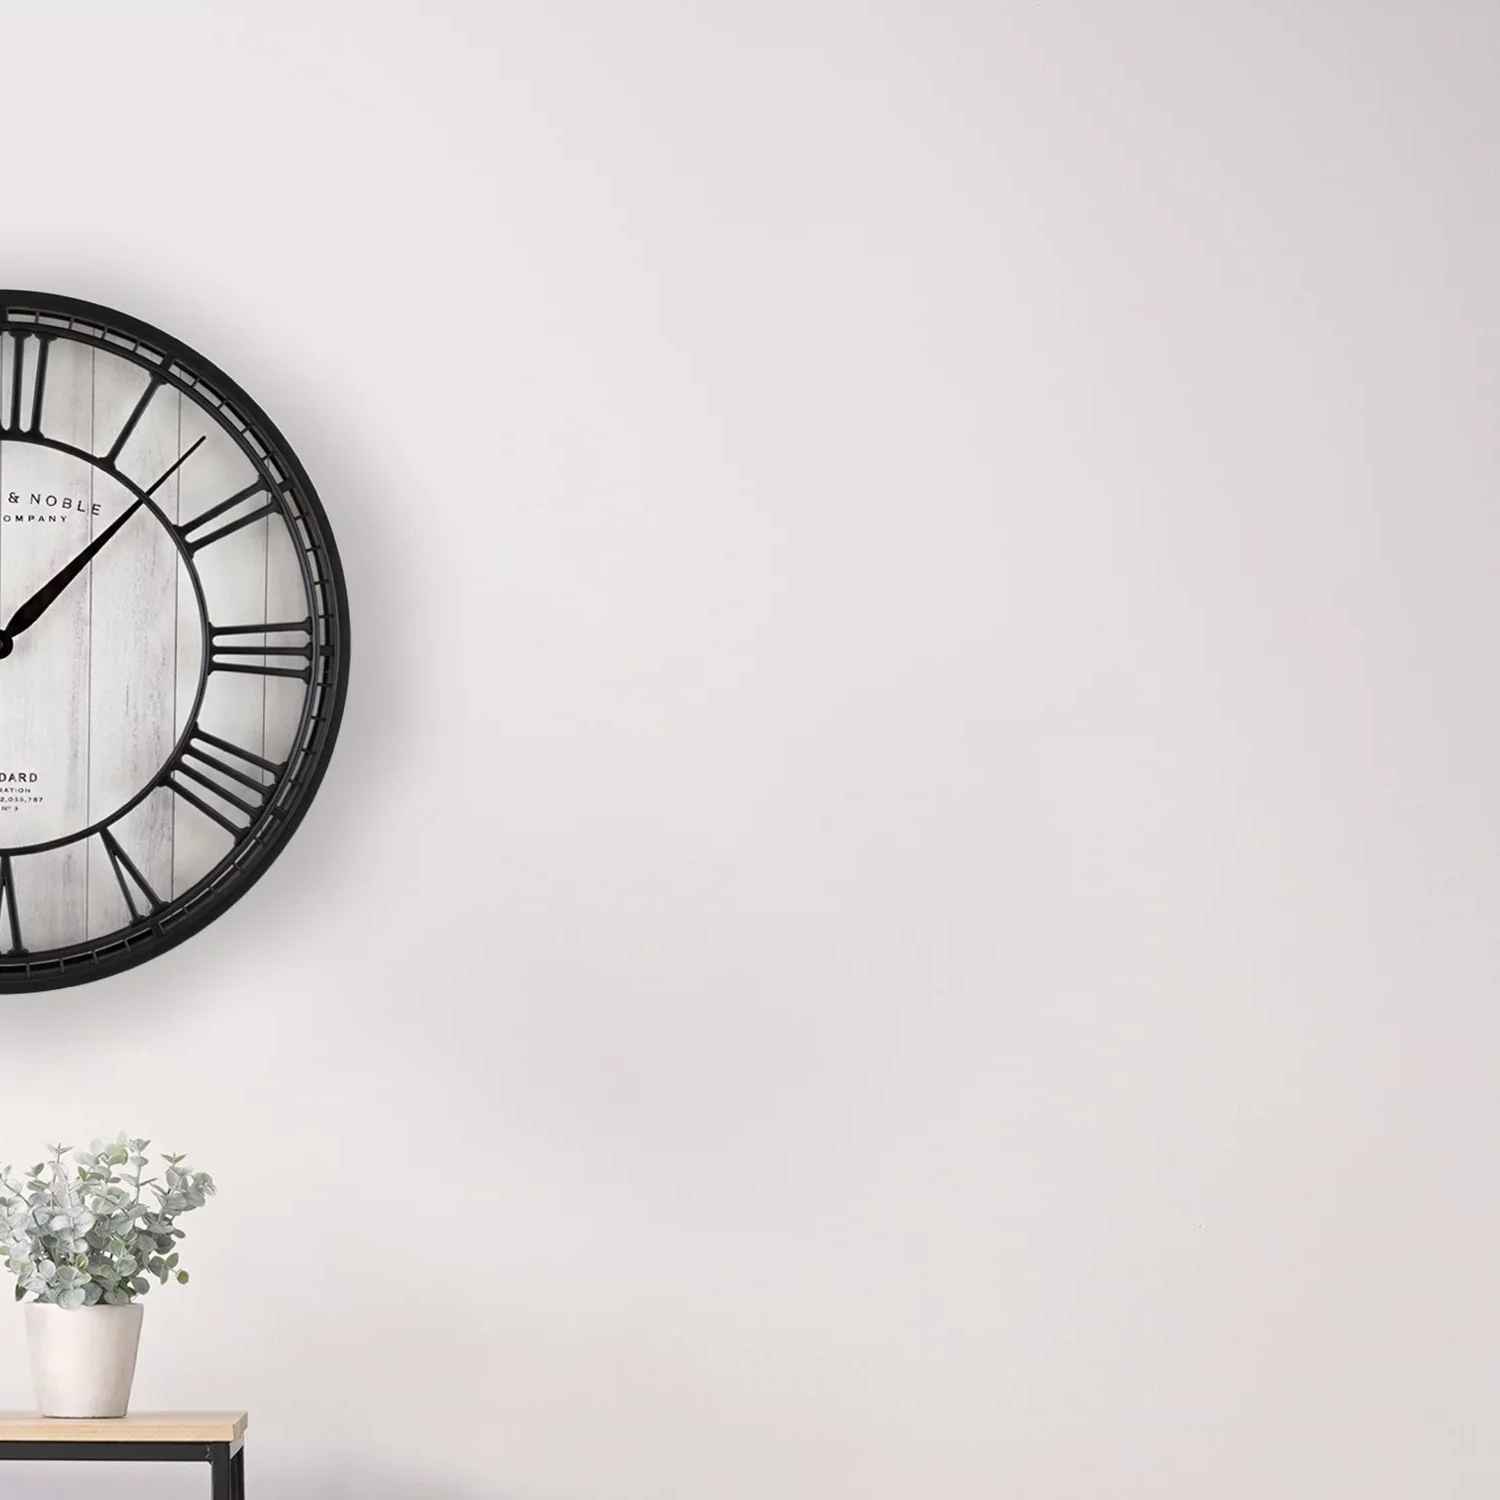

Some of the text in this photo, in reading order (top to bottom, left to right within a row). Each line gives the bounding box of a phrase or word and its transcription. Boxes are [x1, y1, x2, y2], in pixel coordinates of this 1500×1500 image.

[100, 371, 169, 470] I
[8, 491, 20, 504] &
[30, 493, 102, 516] NOBLE
[172, 472, 284, 558] II
[208, 616, 313, 683] III
[100, 824, 172, 927] V
